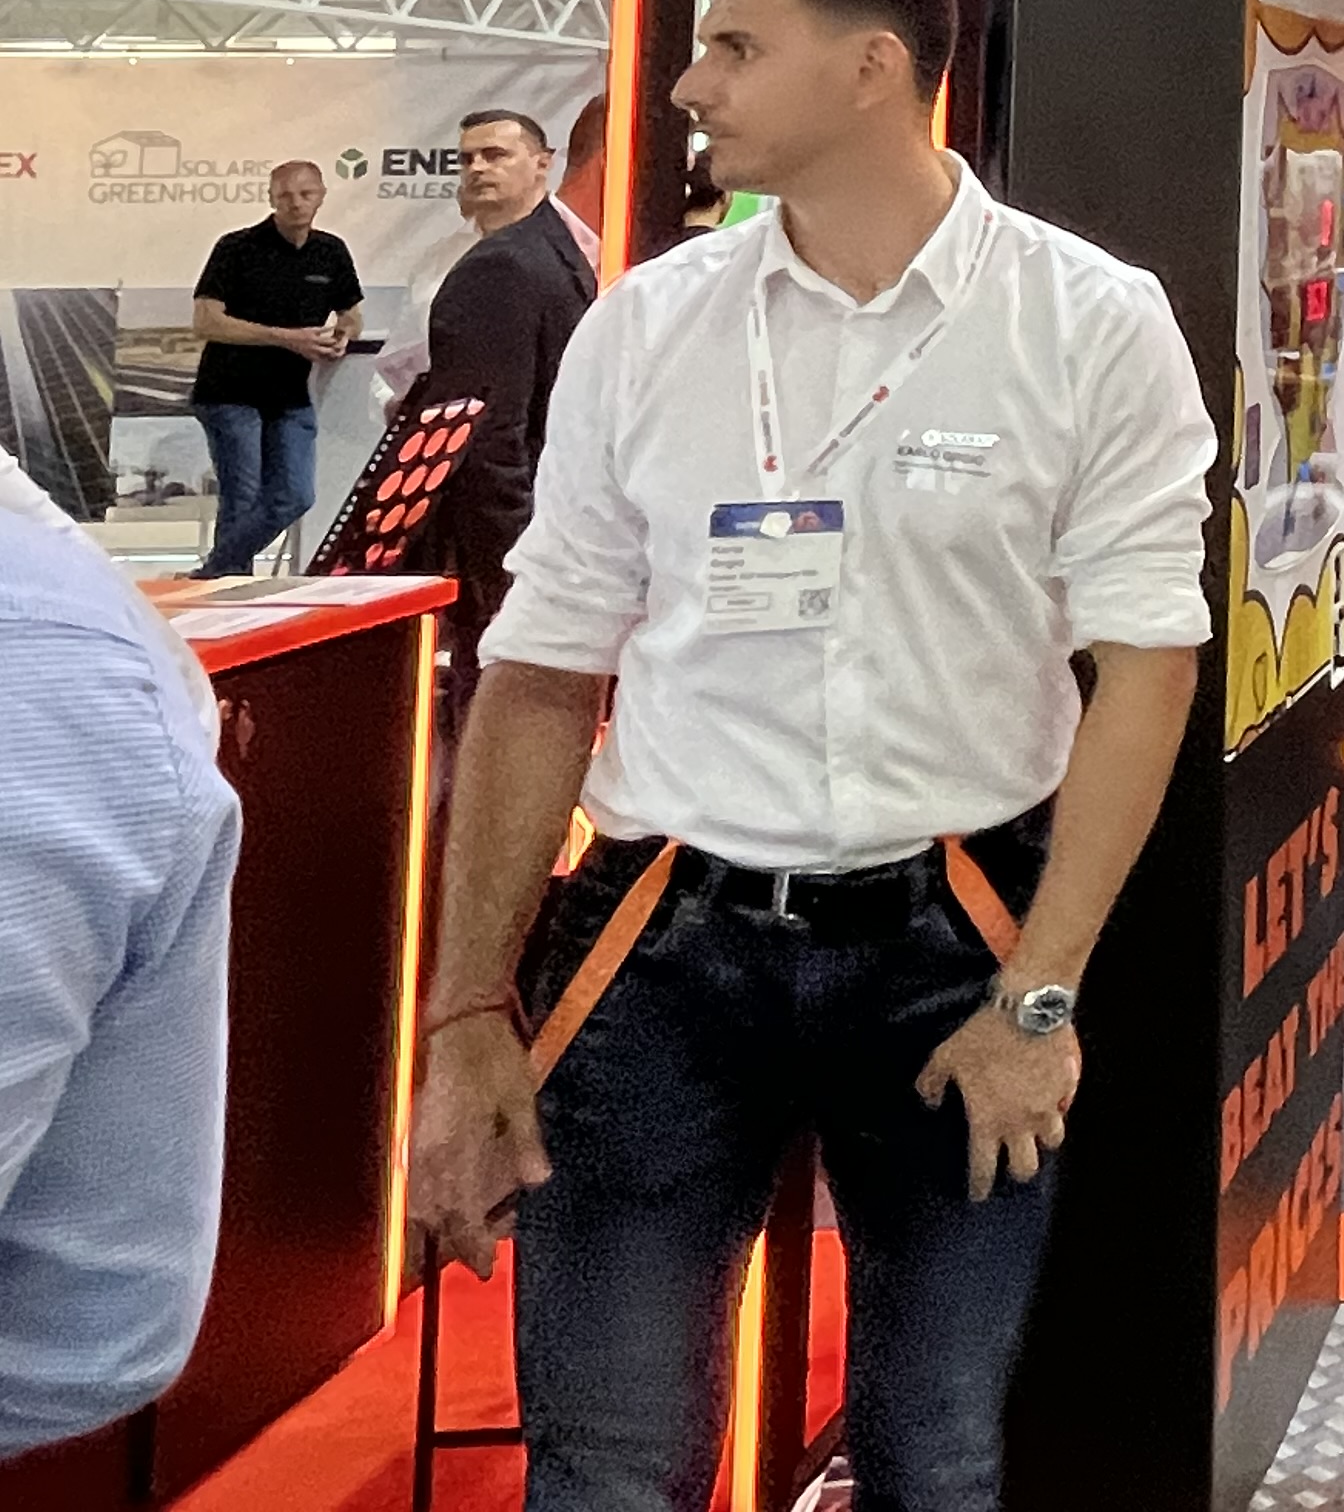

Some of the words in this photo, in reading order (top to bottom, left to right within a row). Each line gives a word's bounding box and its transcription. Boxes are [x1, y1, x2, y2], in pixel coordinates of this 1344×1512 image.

[1243, 786, 1341, 999] LET'S
[1220, 1004, 1299, 1194] BEAT
[1219, 1091, 1343, 1415] PRICES
